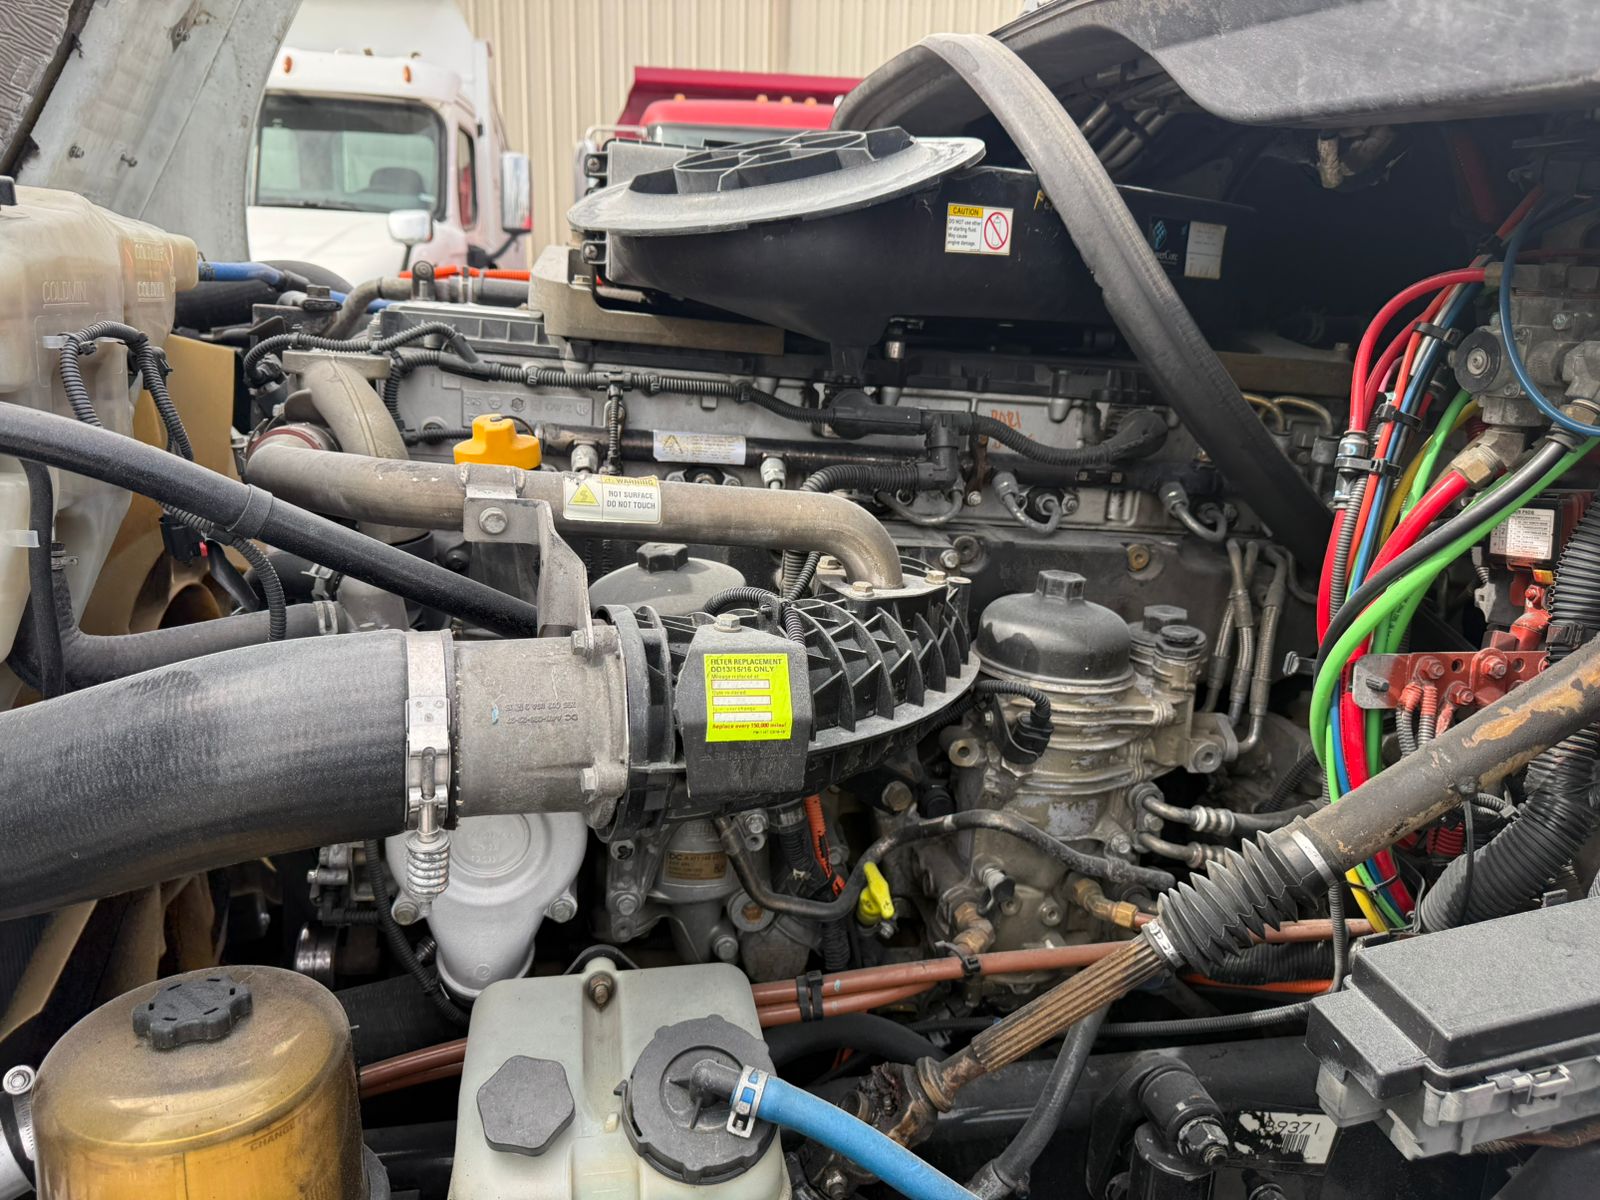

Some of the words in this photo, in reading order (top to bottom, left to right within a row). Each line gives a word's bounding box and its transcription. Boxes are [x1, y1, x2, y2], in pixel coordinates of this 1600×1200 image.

[952, 206, 979, 216] CAUTION
[623, 491, 654, 500] SURFACE
[606, 500, 617, 508] DO
[618, 501, 632, 509] NOT
[633, 502, 656, 510] TOUCH
